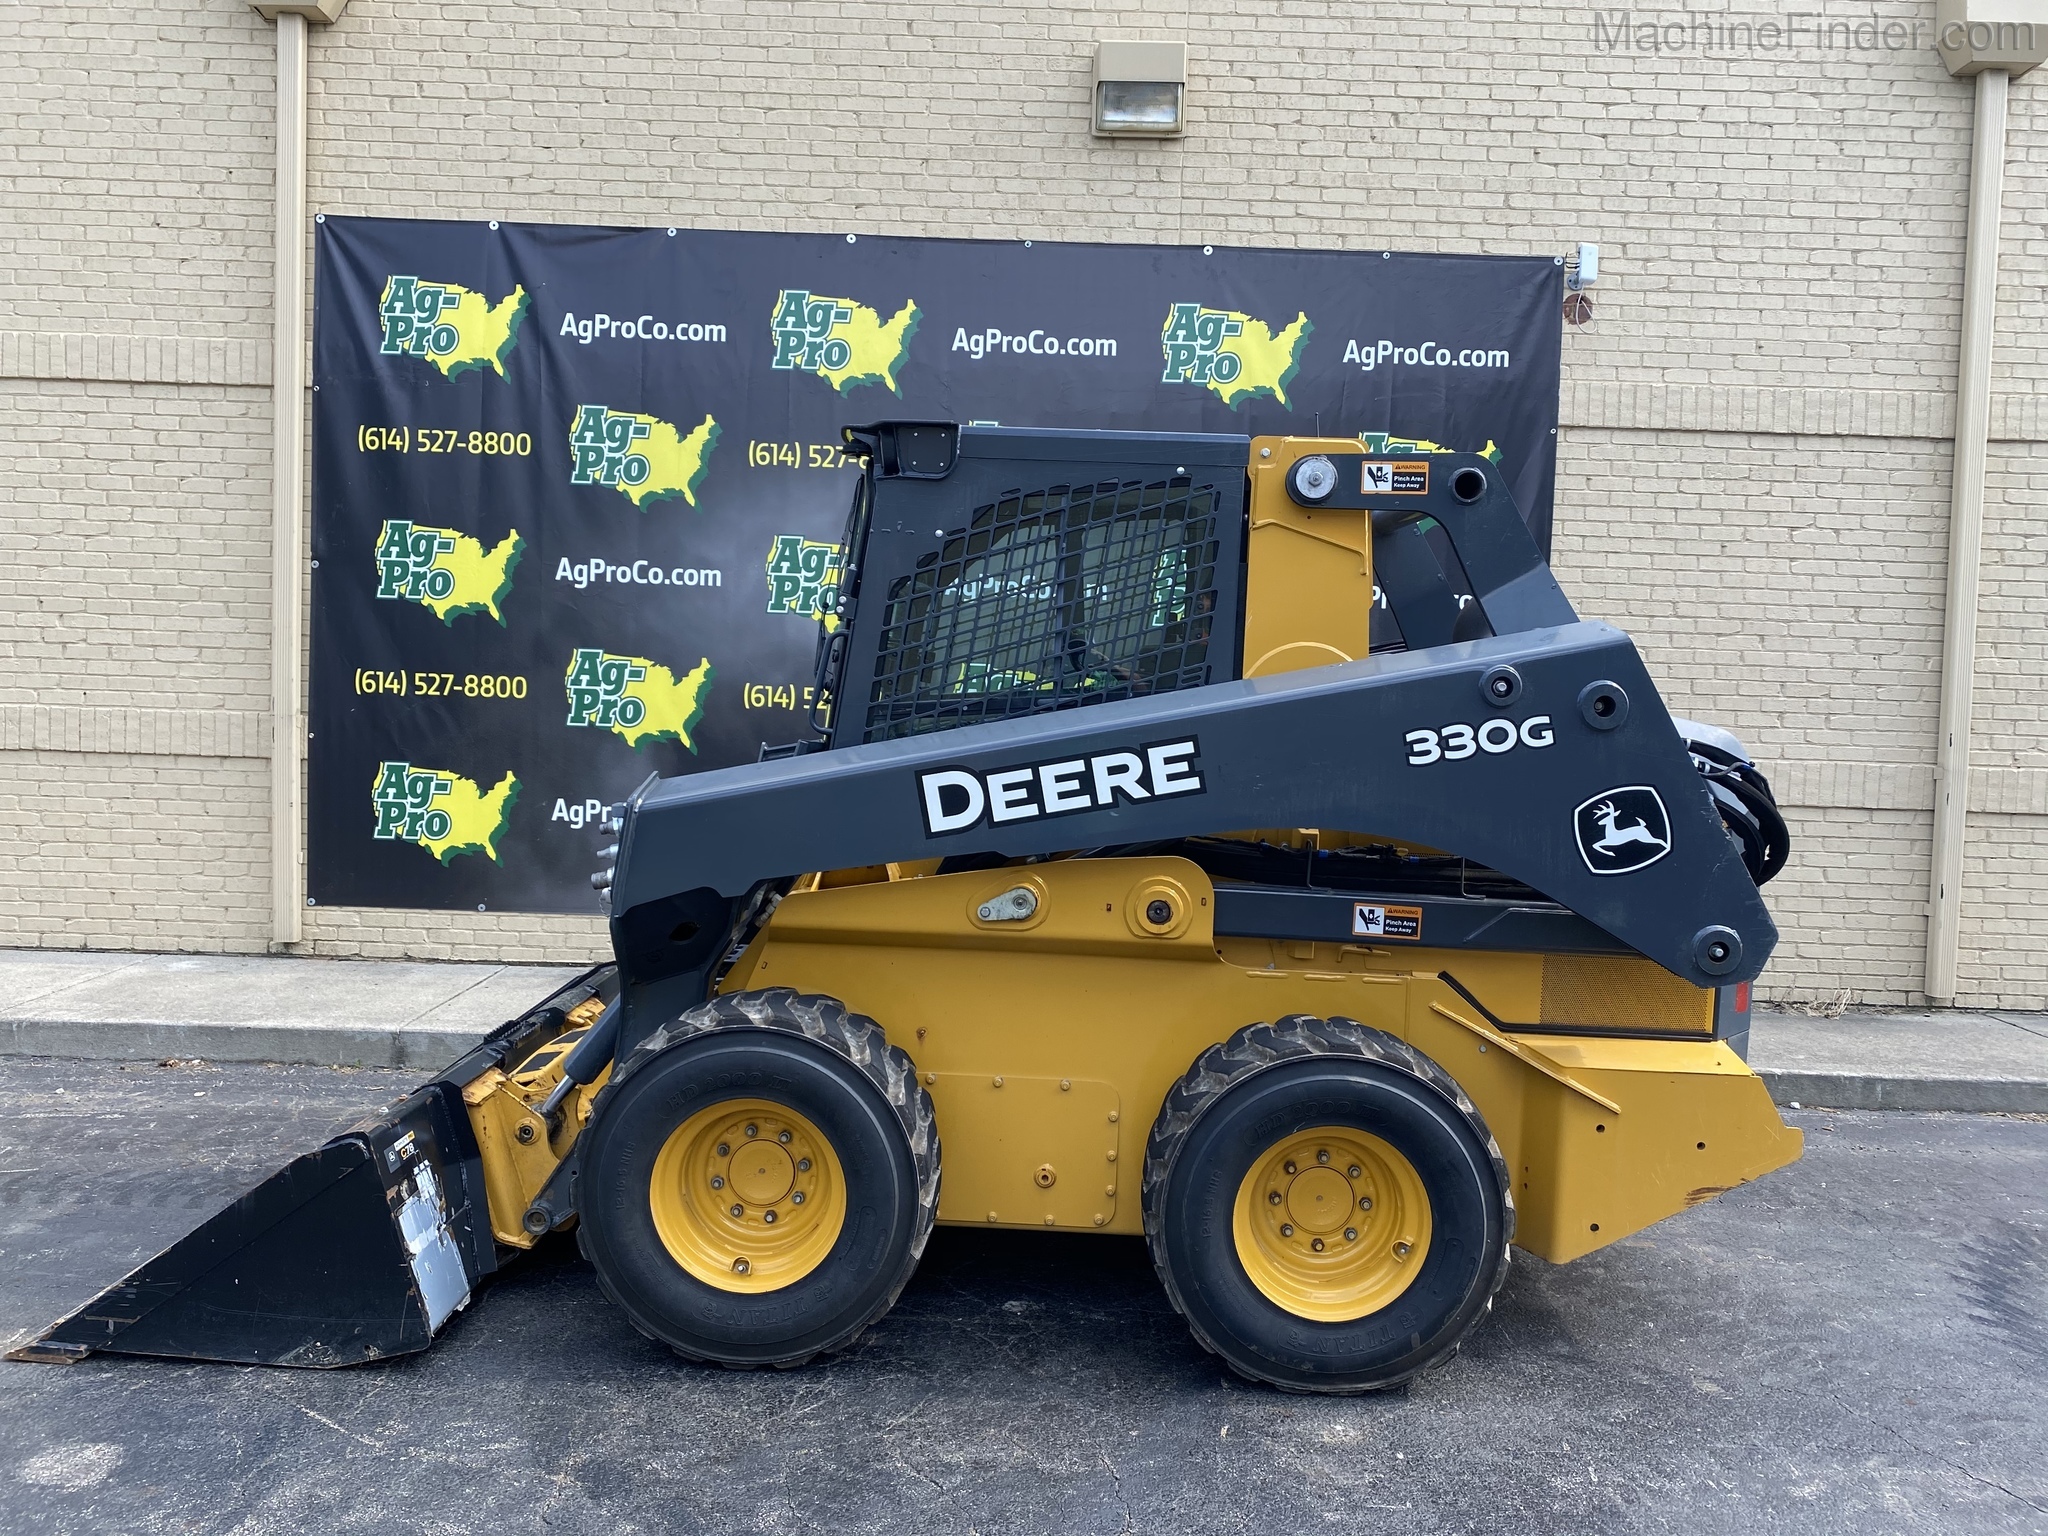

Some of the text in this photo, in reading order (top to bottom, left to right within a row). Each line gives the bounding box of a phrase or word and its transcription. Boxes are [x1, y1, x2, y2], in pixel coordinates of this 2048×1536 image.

[381, 275, 460, 324] Ag-
[773, 290, 851, 339] Ag-
[380, 313, 459, 354] Pro
[559, 312, 727, 345] AgProCo.com
[772, 328, 850, 369] Pro
[951, 327, 1118, 360] AgProCo.com
[1164, 303, 1243, 353] Ag-
[1162, 342, 1240, 383] Pro
[1342, 339, 1510, 371] AgProCo.com
[357, 425, 532, 456] (614) 527-8800
[571, 405, 650, 454] Ag-
[571, 443, 650, 485] Pro
[748, 440, 800, 469] (614)
[377, 520, 455, 569] Ag-
[377, 558, 454, 599] Pro
[554, 556, 722, 589] AgProCo.com
[353, 668, 528, 700] (614) 527-8800
[567, 648, 645, 697] Ag-
[567, 686, 645, 727] Pro
[743, 682, 796, 711] (614)
[1405, 715, 1555, 766] 330G
[374, 762, 451, 809] Ag-
[921, 740, 1201, 833] DEERE
[374, 799, 451, 840] Pro
[667, 1083, 699, 1110] HD
[704, 1072, 762, 1090] 2000
[1312, 1322, 1396, 1353] TITAN
